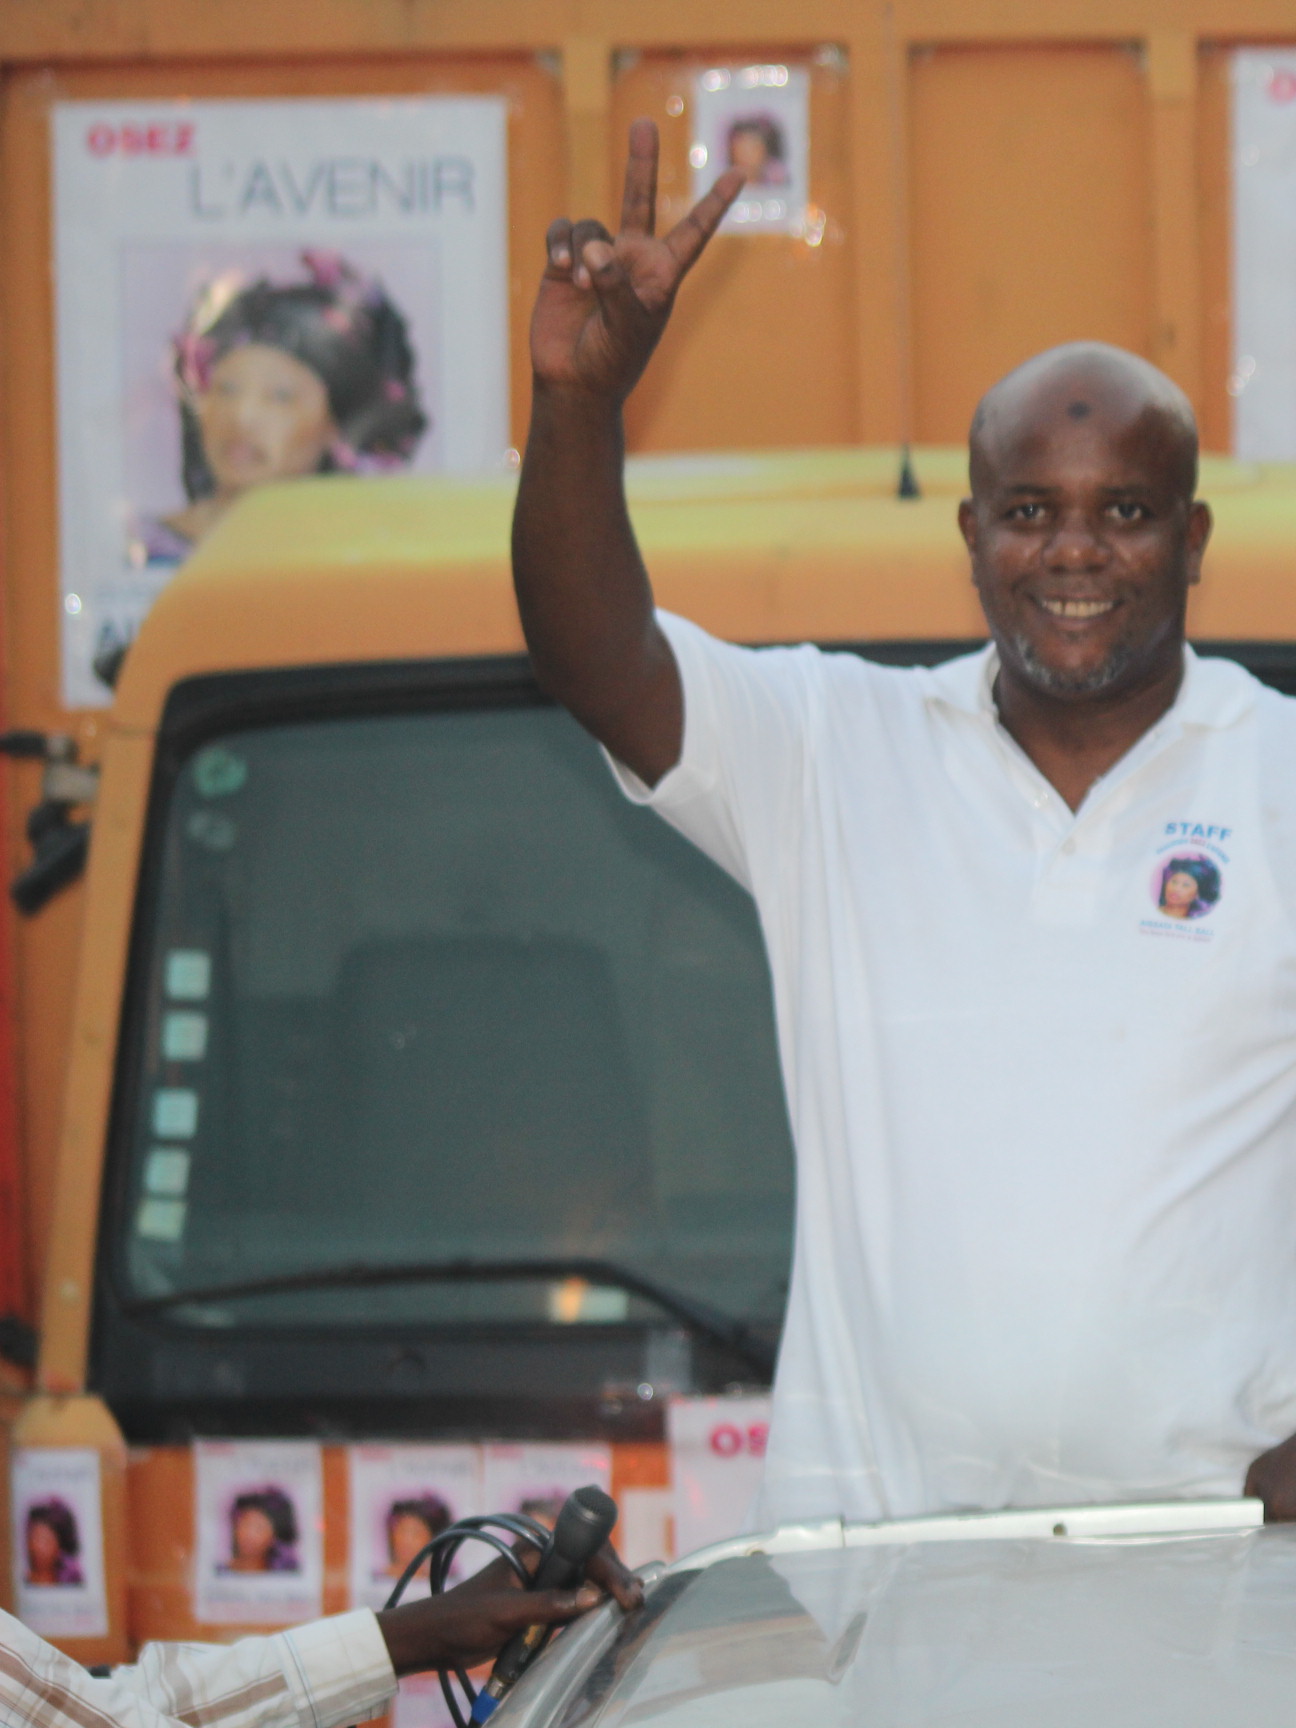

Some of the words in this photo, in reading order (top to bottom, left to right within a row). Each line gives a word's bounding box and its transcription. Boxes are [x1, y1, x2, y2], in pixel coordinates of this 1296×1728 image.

[86, 122, 196, 157] OSEZ
[189, 158, 476, 219] L'AVENIR
[1165, 822, 1232, 840] STAFF
